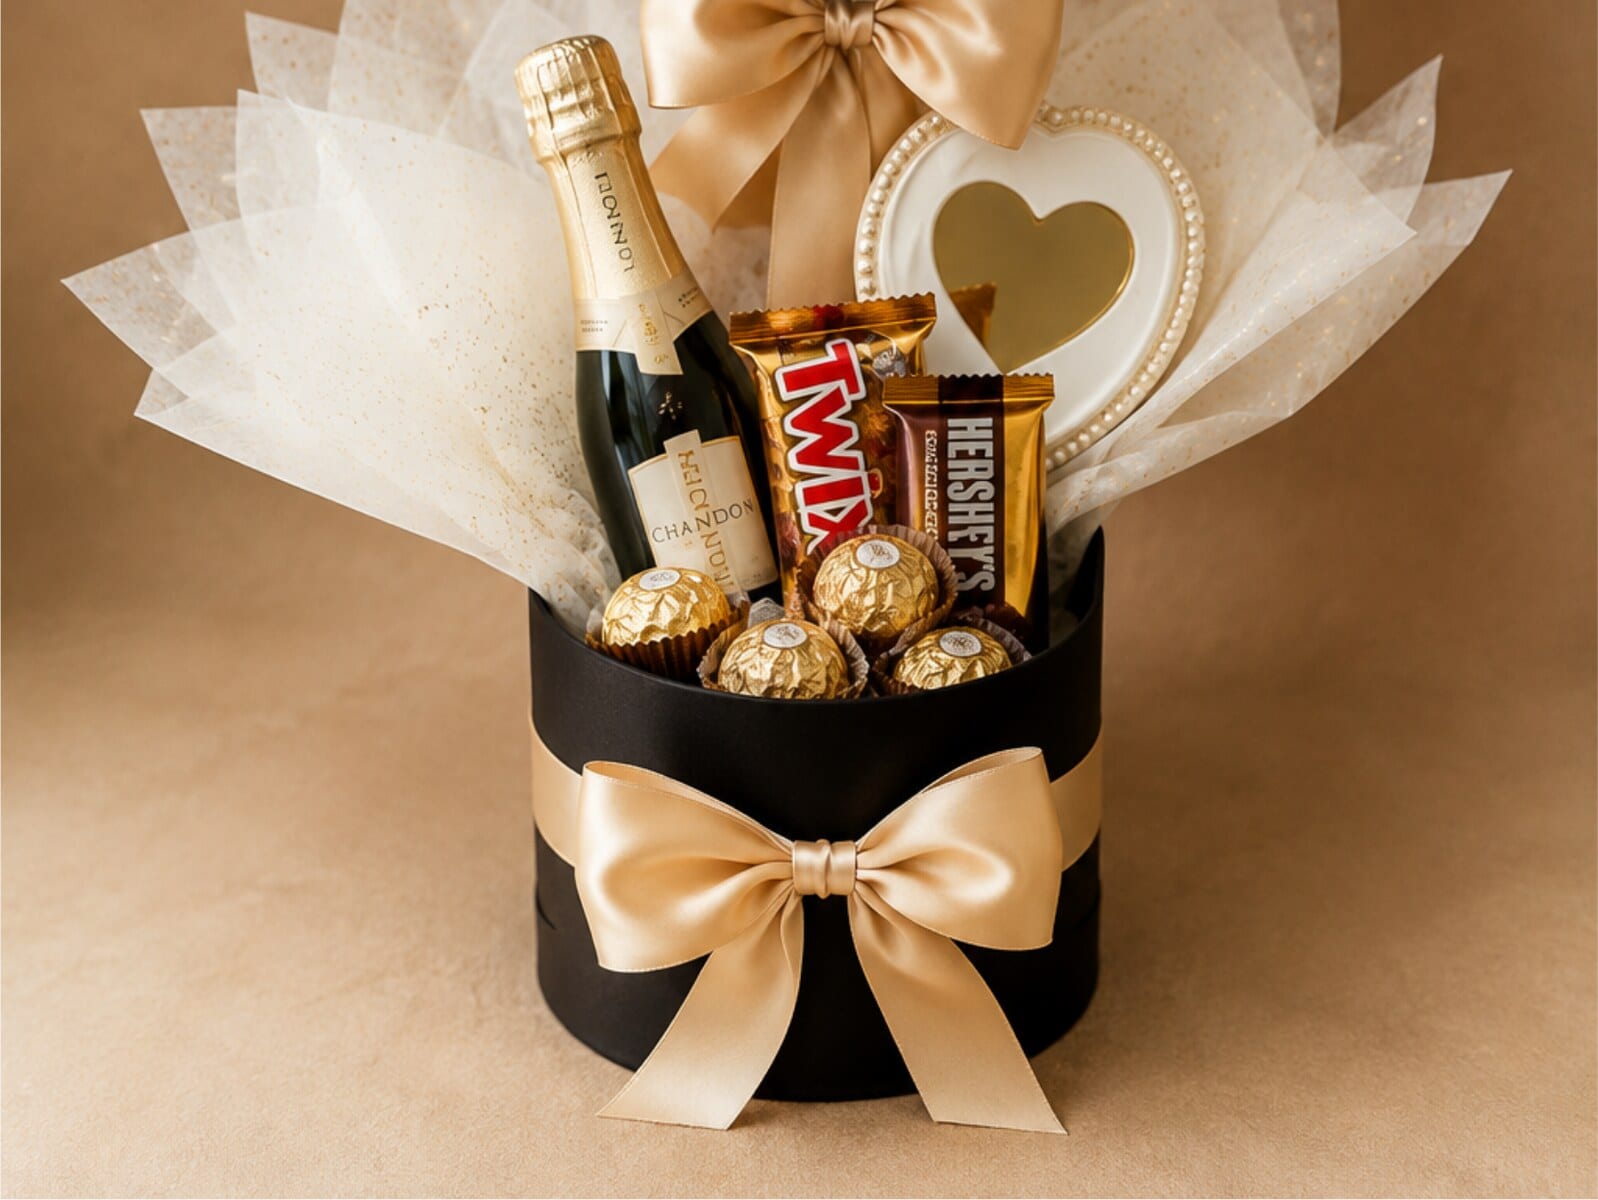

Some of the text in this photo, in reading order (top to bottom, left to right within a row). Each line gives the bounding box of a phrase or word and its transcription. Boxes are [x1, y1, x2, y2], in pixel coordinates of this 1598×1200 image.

[651, 497, 754, 544] CHANDON
[775, 338, 873, 556] TWIX
[947, 417, 996, 593] HERSHEY'S
